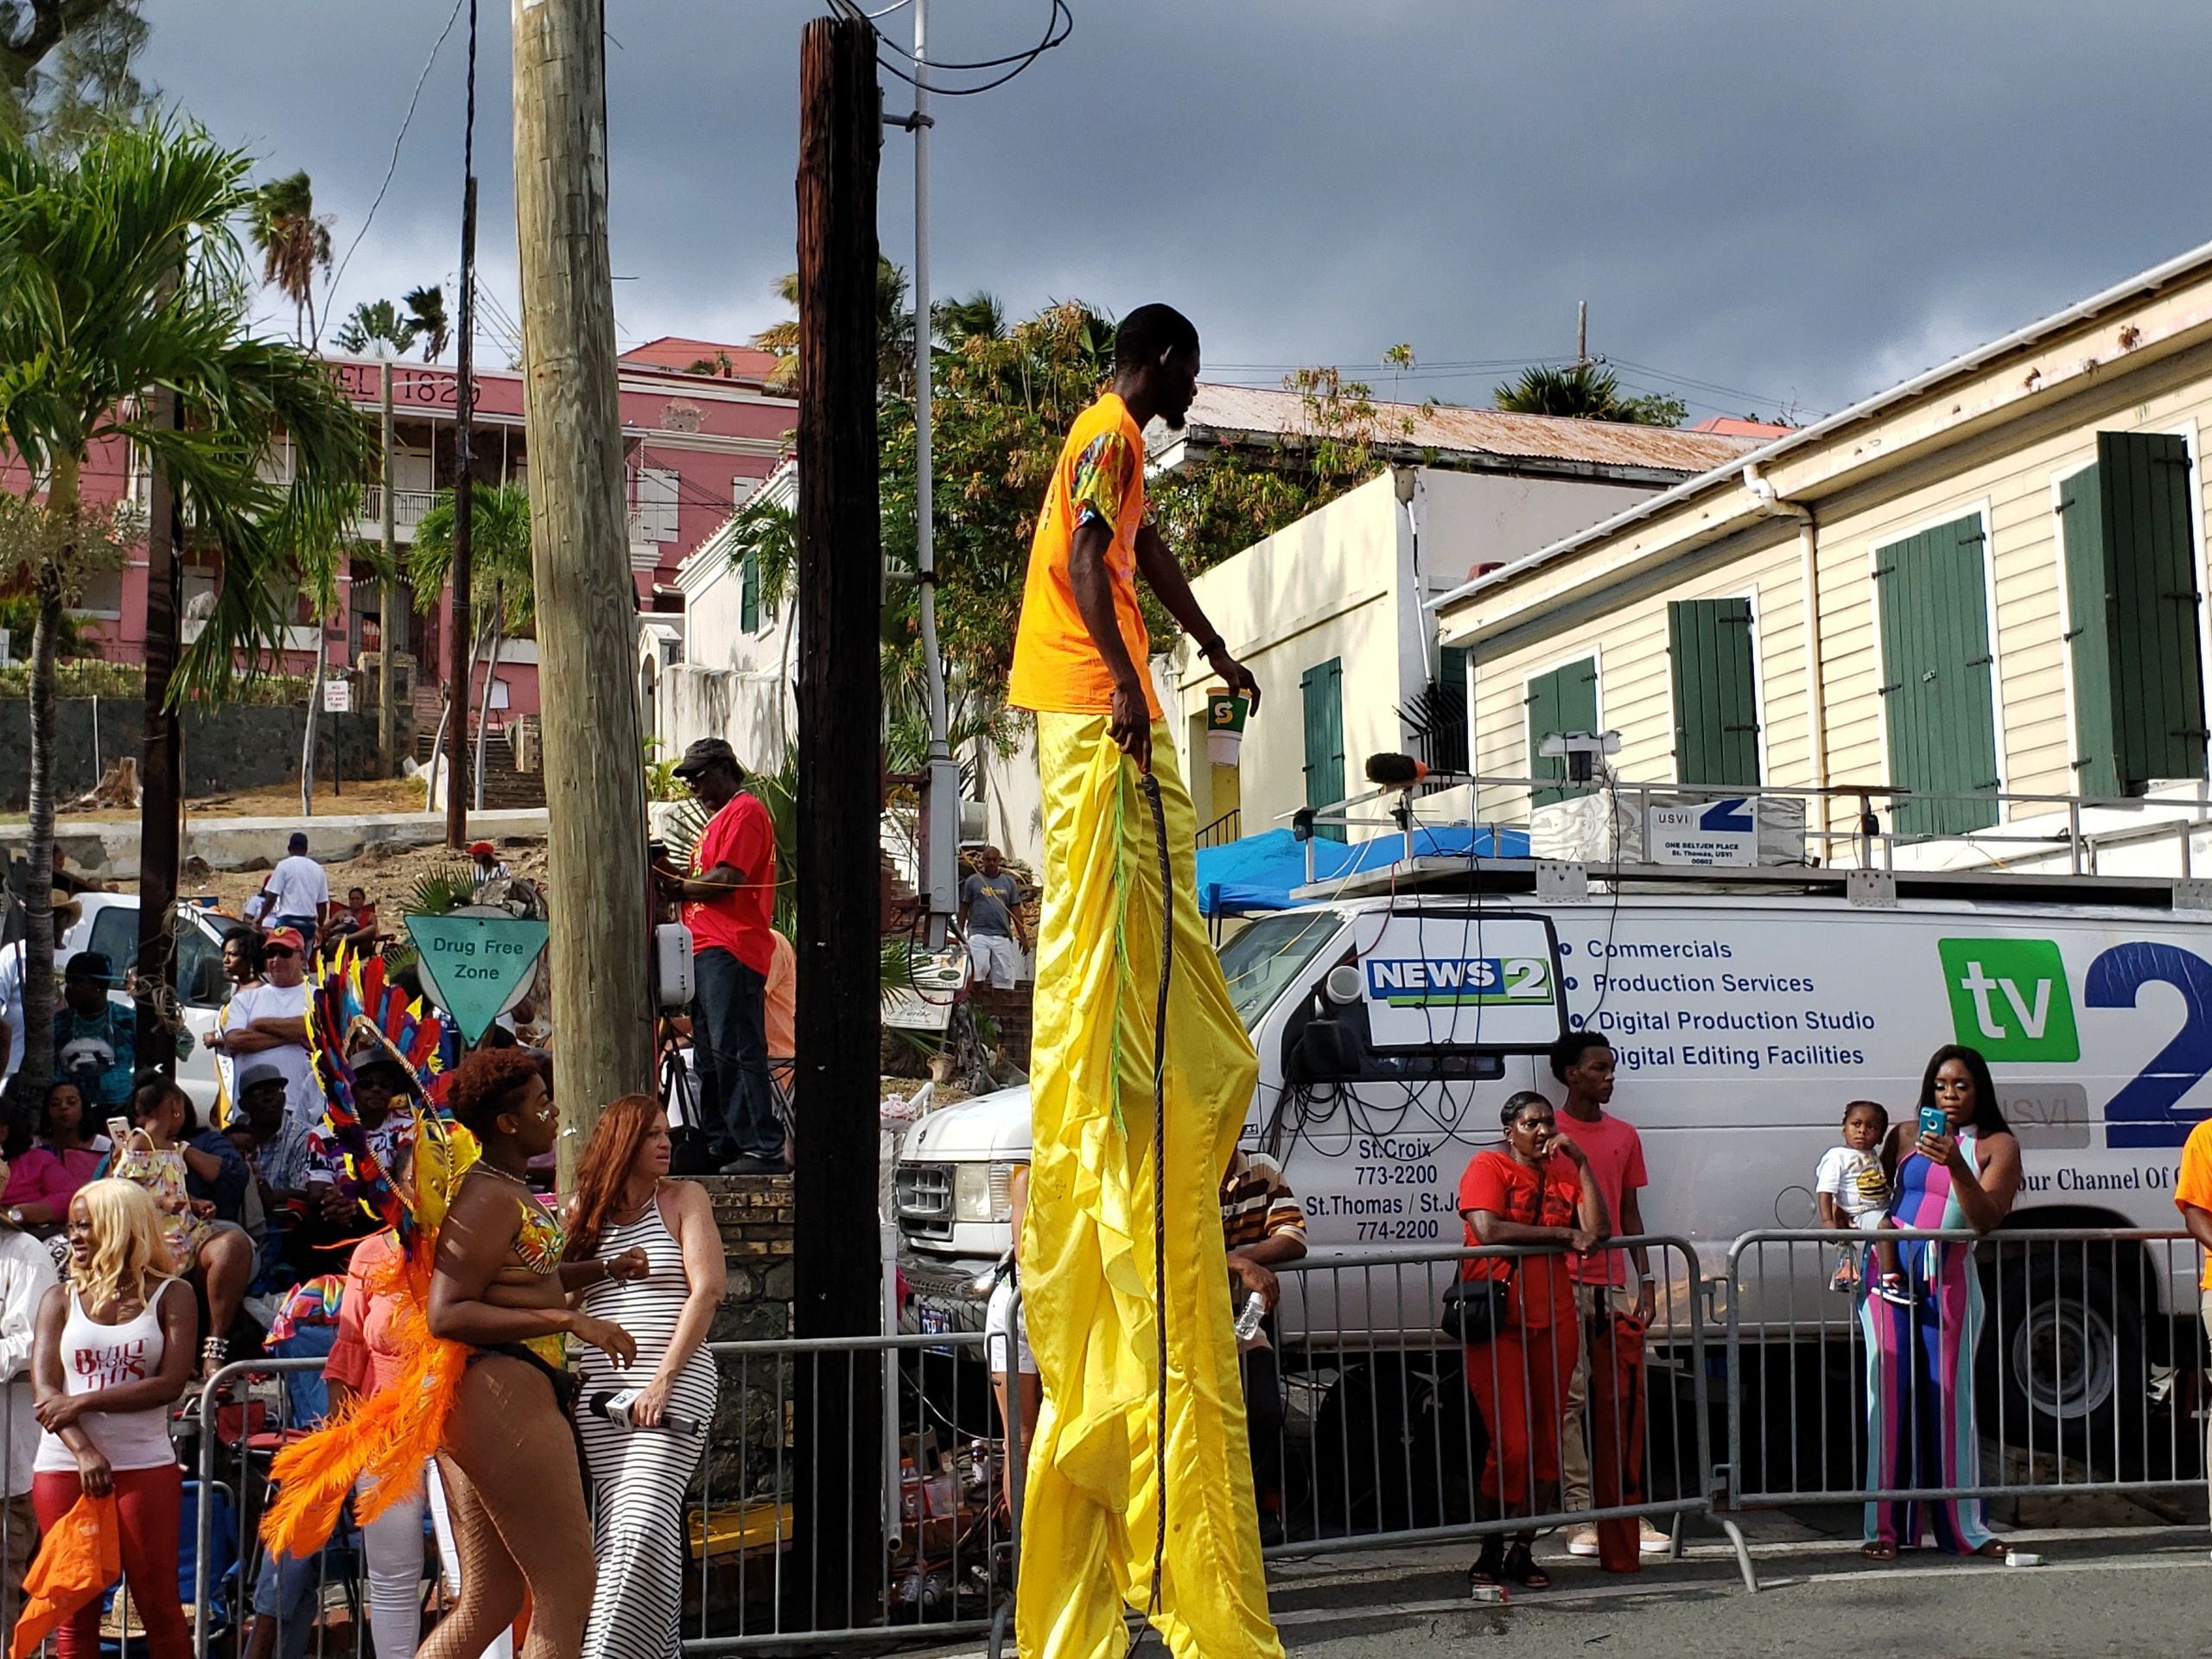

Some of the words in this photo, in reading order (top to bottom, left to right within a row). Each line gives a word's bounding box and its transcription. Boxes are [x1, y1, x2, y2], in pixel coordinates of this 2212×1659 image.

[1658, 814, 1688, 823] USVI
[434, 938, 475, 956] Drug
[485, 940, 524, 954] Free
[1586, 940, 1732, 958] Commercials
[454, 964, 499, 979] Zone
[1373, 961, 1495, 988] NEWS
[1504, 959, 1548, 997] 2
[1593, 974, 1714, 992] Production
[1722, 973, 1815, 992] Services
[1961, 961, 2051, 1039] tv
[1599, 1012, 1670, 1035] Digital
[1678, 1012, 1798, 1030] Production
[1805, 1011, 1875, 1030] Studio
[1682, 1046, 1760, 1071] Editing
[1768, 1046, 1864, 1065] Facilities
[1359, 1138, 1432, 1159] St.Croix
[1355, 1165, 1437, 1185] 773-2200
[2057, 1167, 2140, 1191] Channel
[2145, 1166, 2169, 1189] Of
[1306, 1195, 1402, 1217] St.Thomas
[1357, 1219, 1439, 1240] 774-2200
[74, 1338, 149, 1375] BUILT
[98, 1357, 130, 1370] FOR
[82, 1358, 145, 1392] THIS
